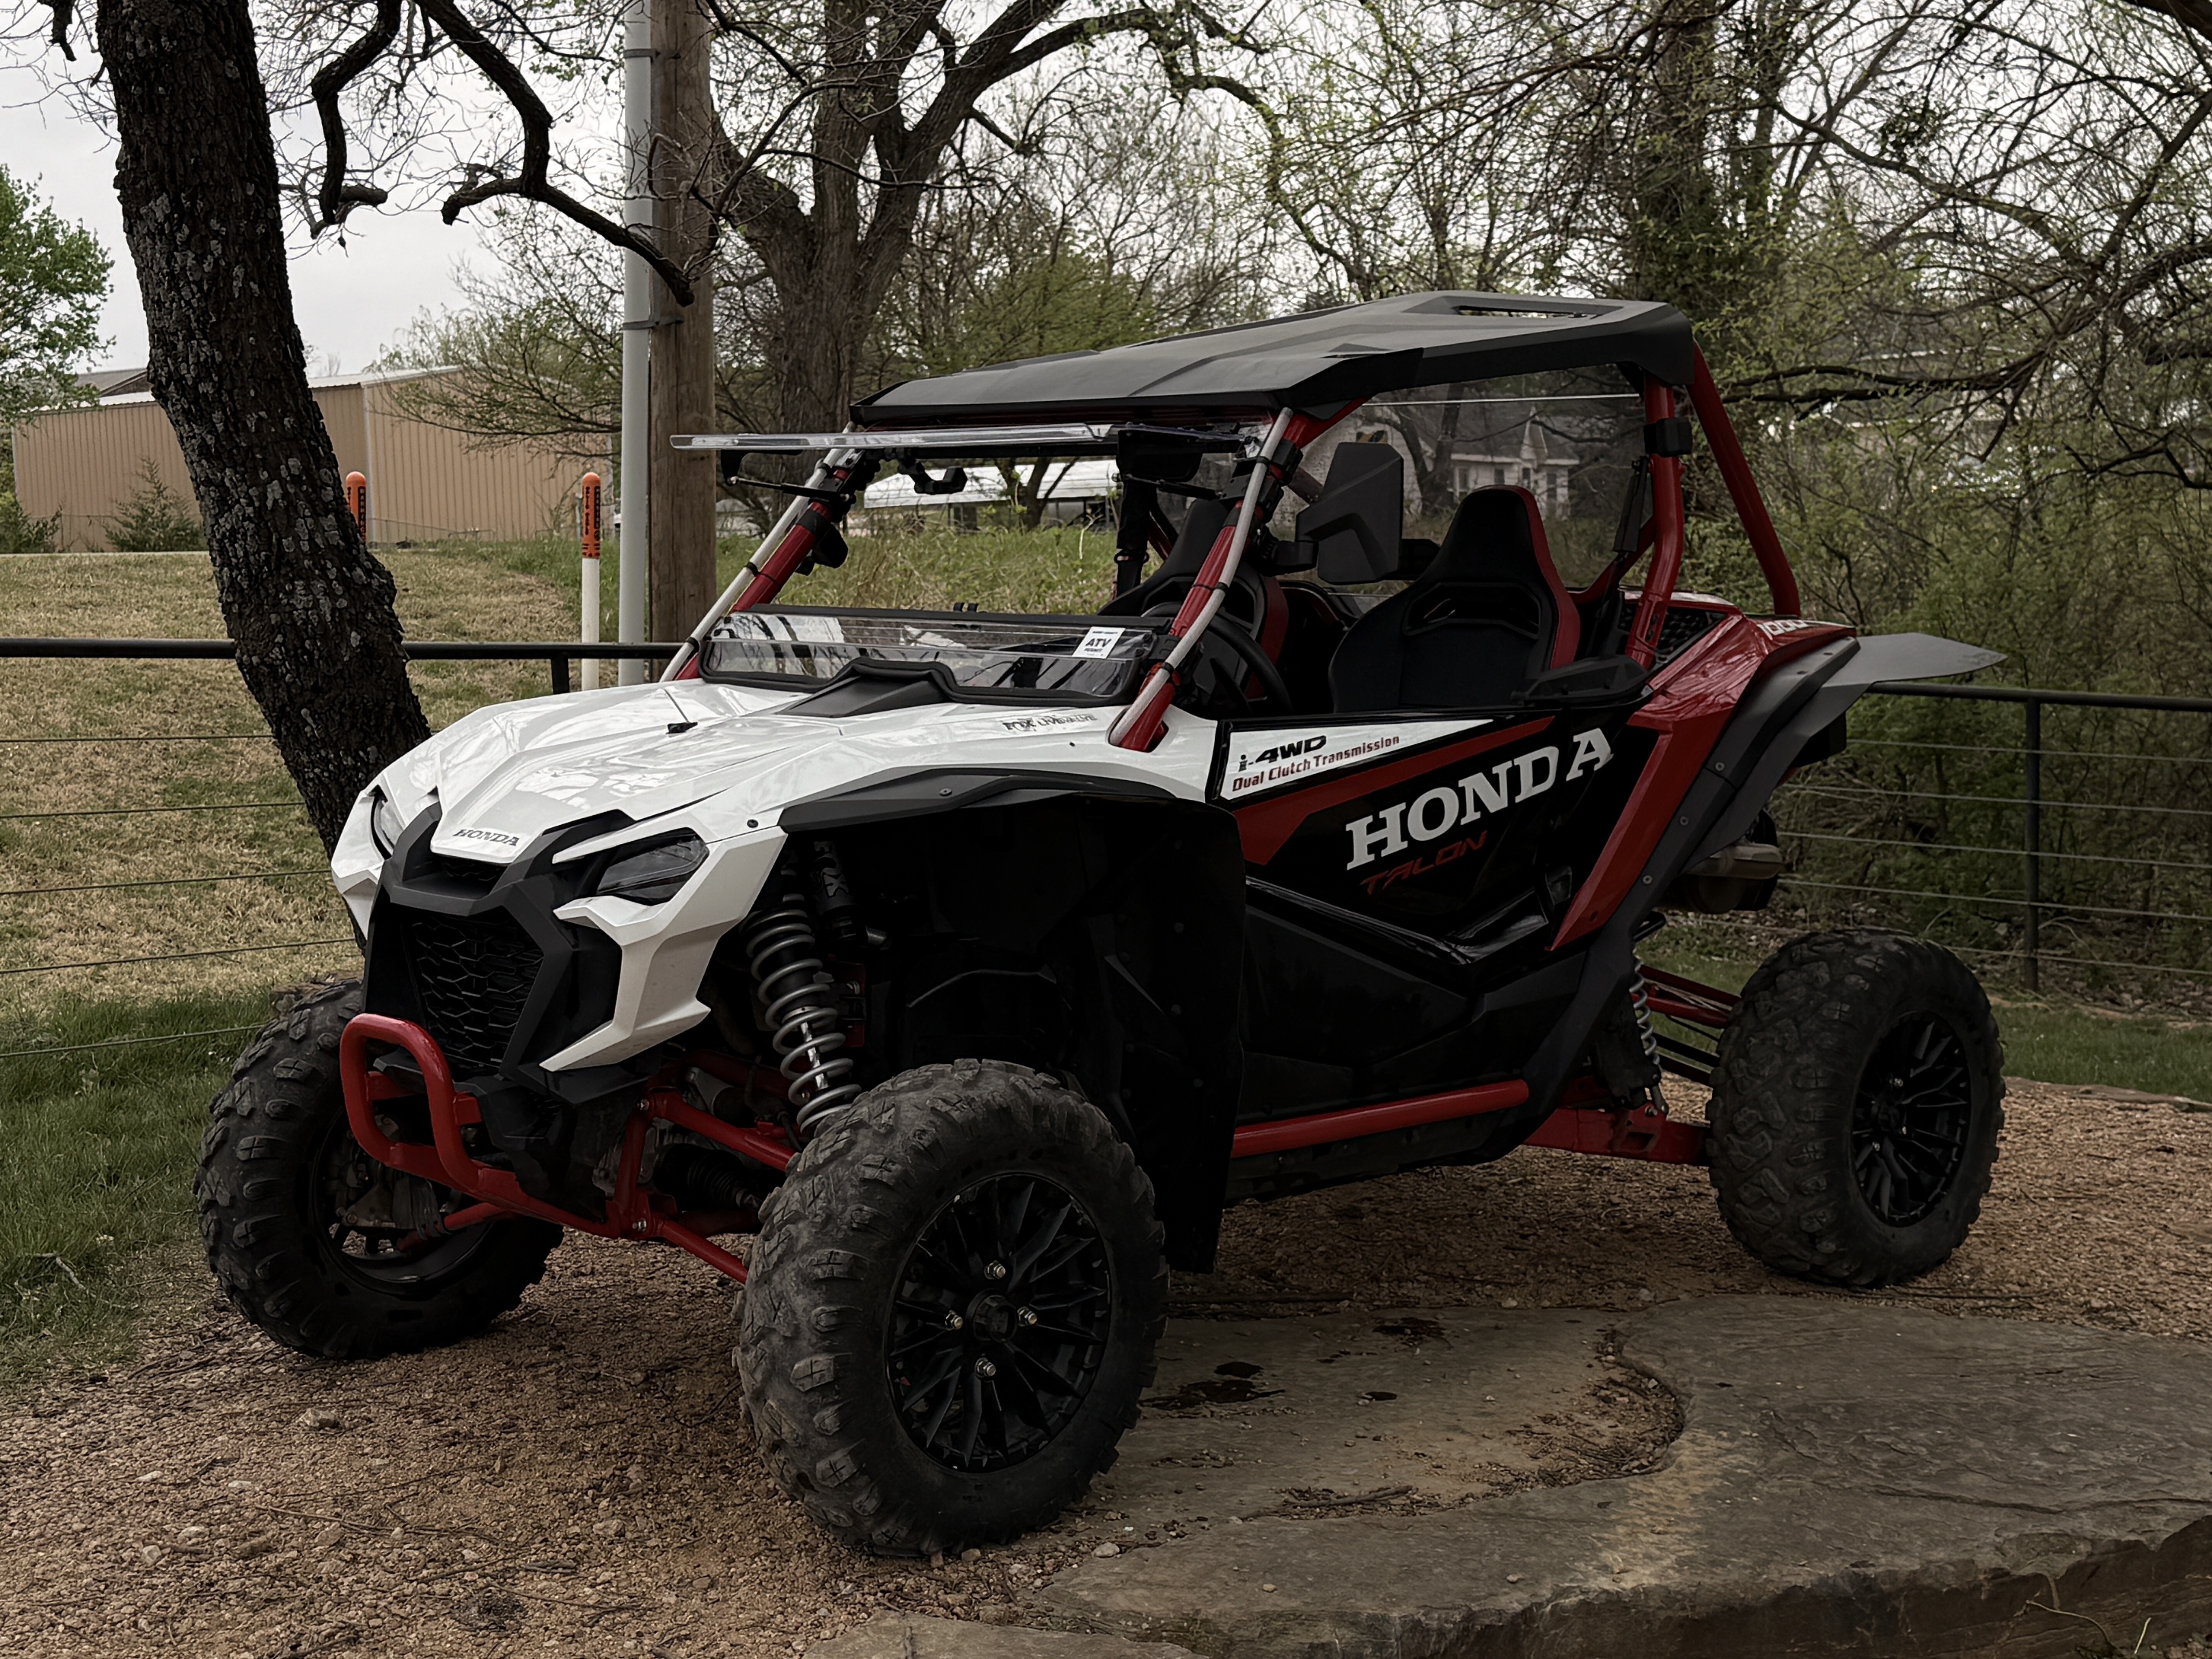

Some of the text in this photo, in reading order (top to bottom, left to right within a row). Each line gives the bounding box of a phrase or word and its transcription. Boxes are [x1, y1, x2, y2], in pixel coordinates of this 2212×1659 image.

[1085, 638, 1112, 647] ATV
[1232, 736, 1400, 792] Dual Clutch Transmission
[1346, 727, 1614, 871] HONDA
[452, 829, 520, 847] HONDA
[1360, 830, 1488, 896] TALON
